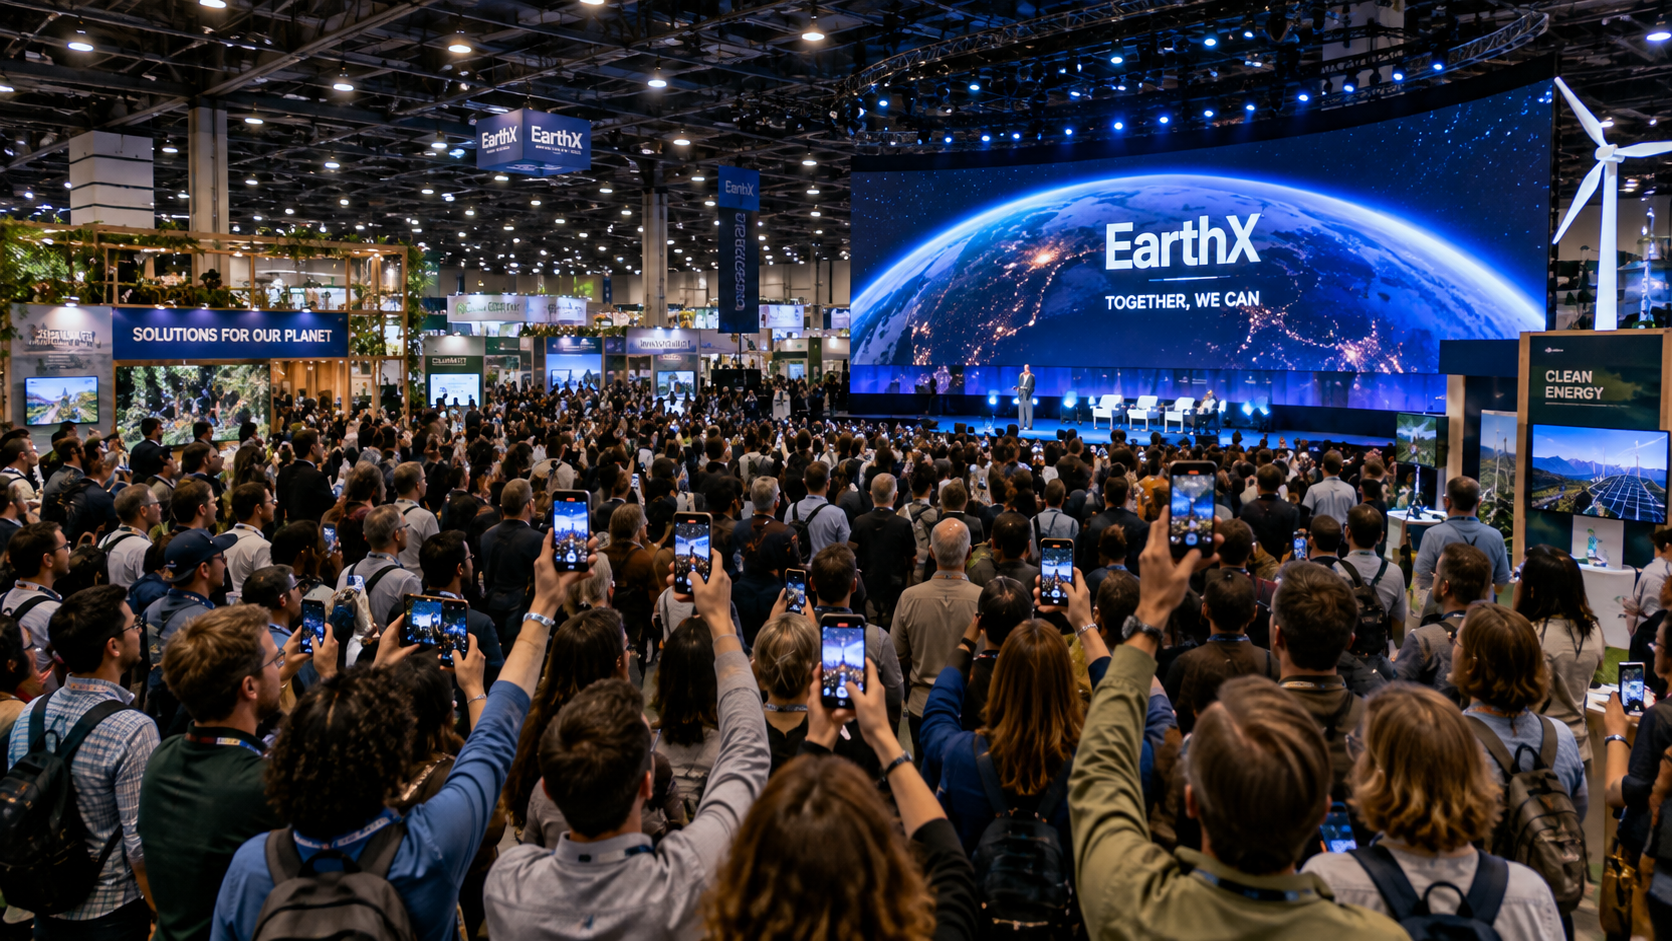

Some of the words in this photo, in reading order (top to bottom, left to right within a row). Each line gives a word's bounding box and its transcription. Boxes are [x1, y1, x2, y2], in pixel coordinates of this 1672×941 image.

[481, 125, 518, 150] EarthX
[531, 125, 583, 150] EarthX
[1105, 212, 1262, 271] EarthX
[1105, 293, 1191, 311] TOGETHER,
[1195, 292, 1220, 308] WE
[1224, 290, 1260, 307] CAN
[132, 326, 218, 343] SOLUTIONS
[221, 327, 250, 343] FOR
[253, 328, 282, 343] OUR
[284, 328, 333, 343] PLANET
[1545, 369, 1593, 384] CLEAN
[1545, 386, 1604, 400] ENERGY
